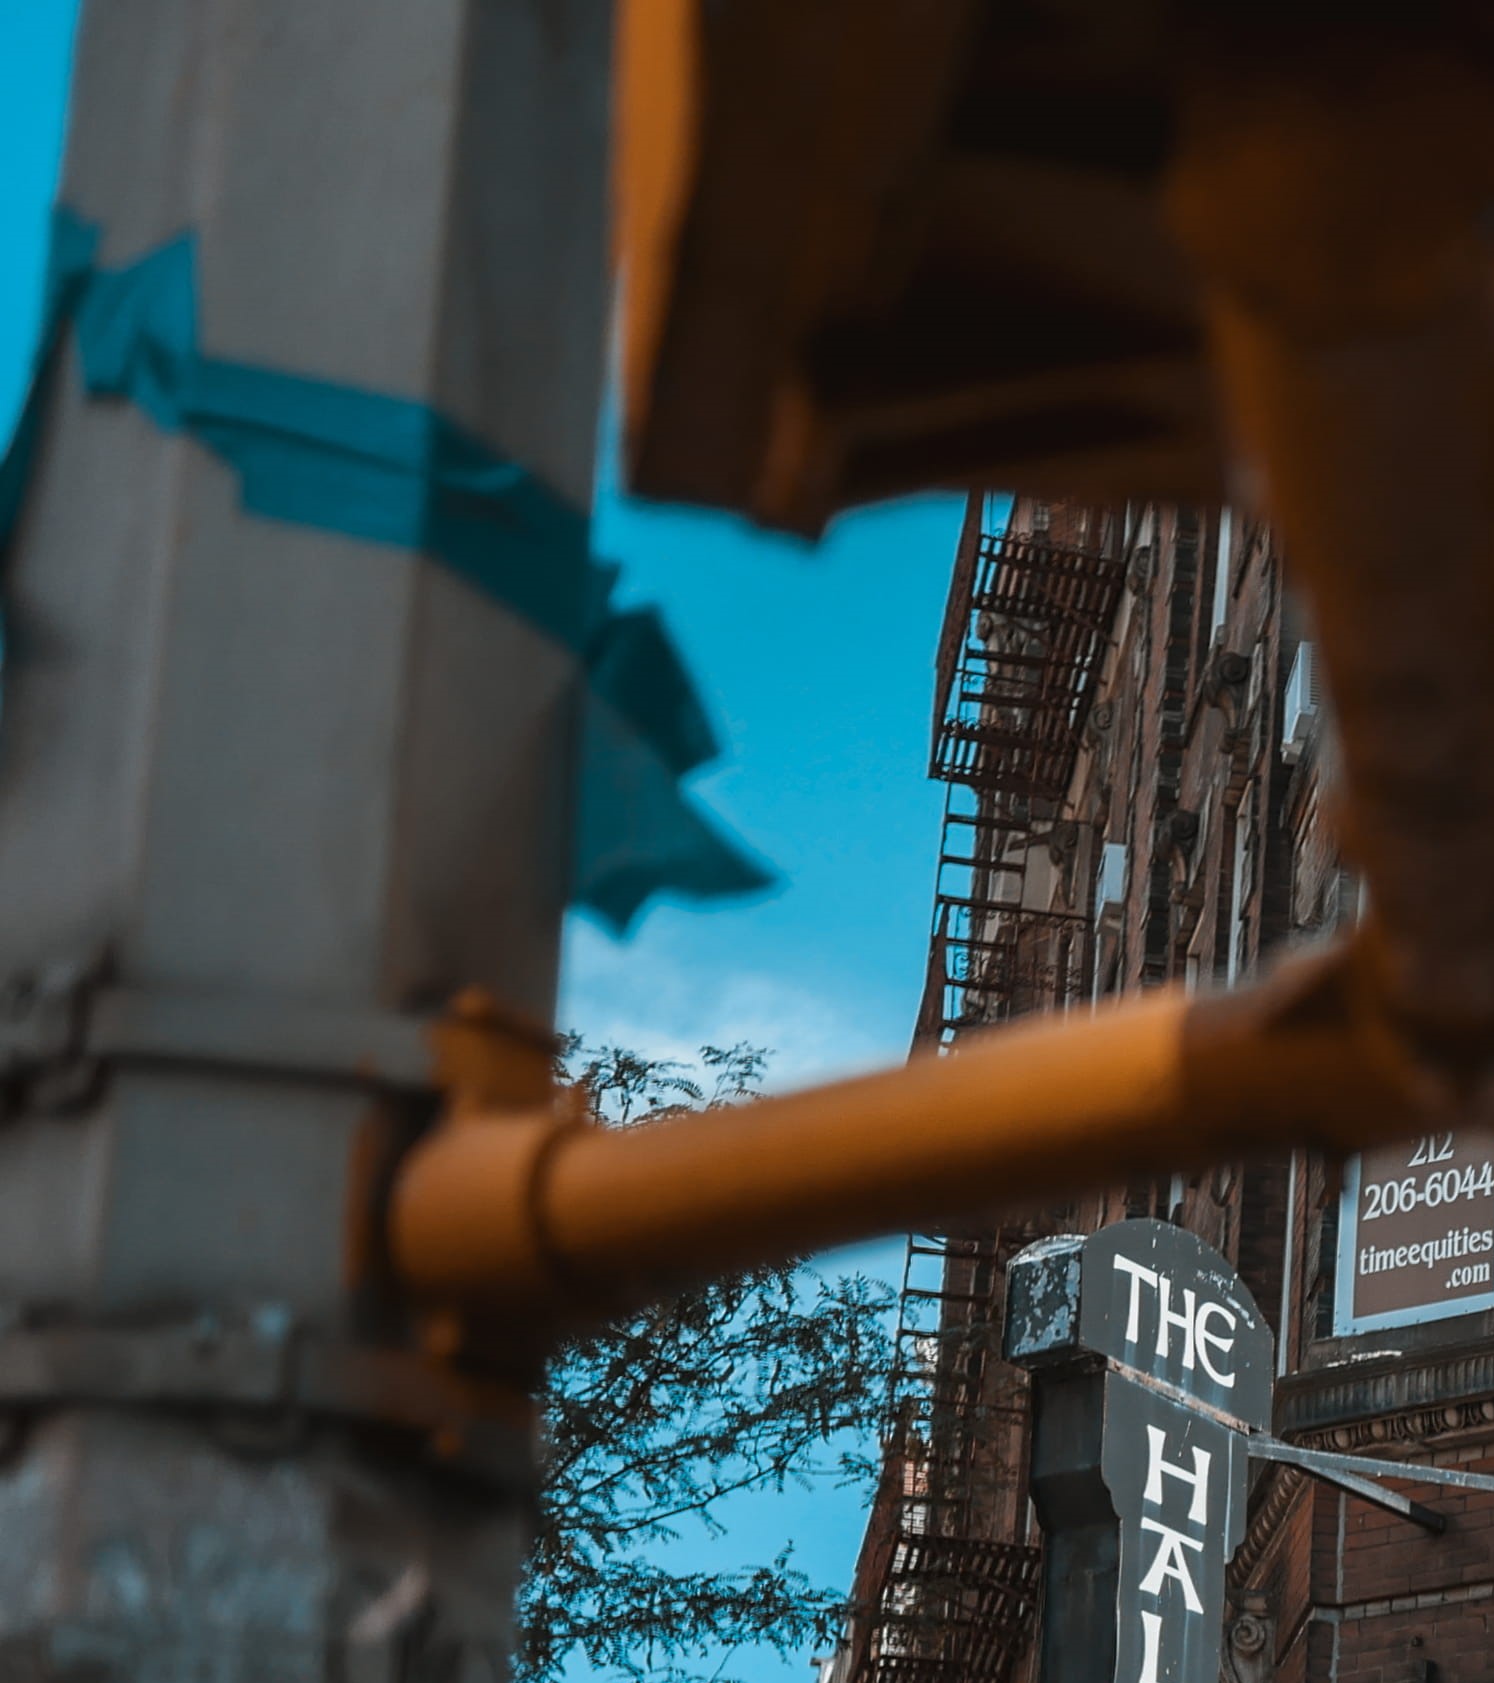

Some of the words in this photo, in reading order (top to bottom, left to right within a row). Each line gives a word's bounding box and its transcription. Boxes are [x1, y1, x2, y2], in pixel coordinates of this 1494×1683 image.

[1406, 1131, 1456, 1168] 212
[1359, 1226, 1494, 1276] timeequities
[1444, 1262, 1491, 1289] .com
[1113, 1253, 1237, 1388] THE
